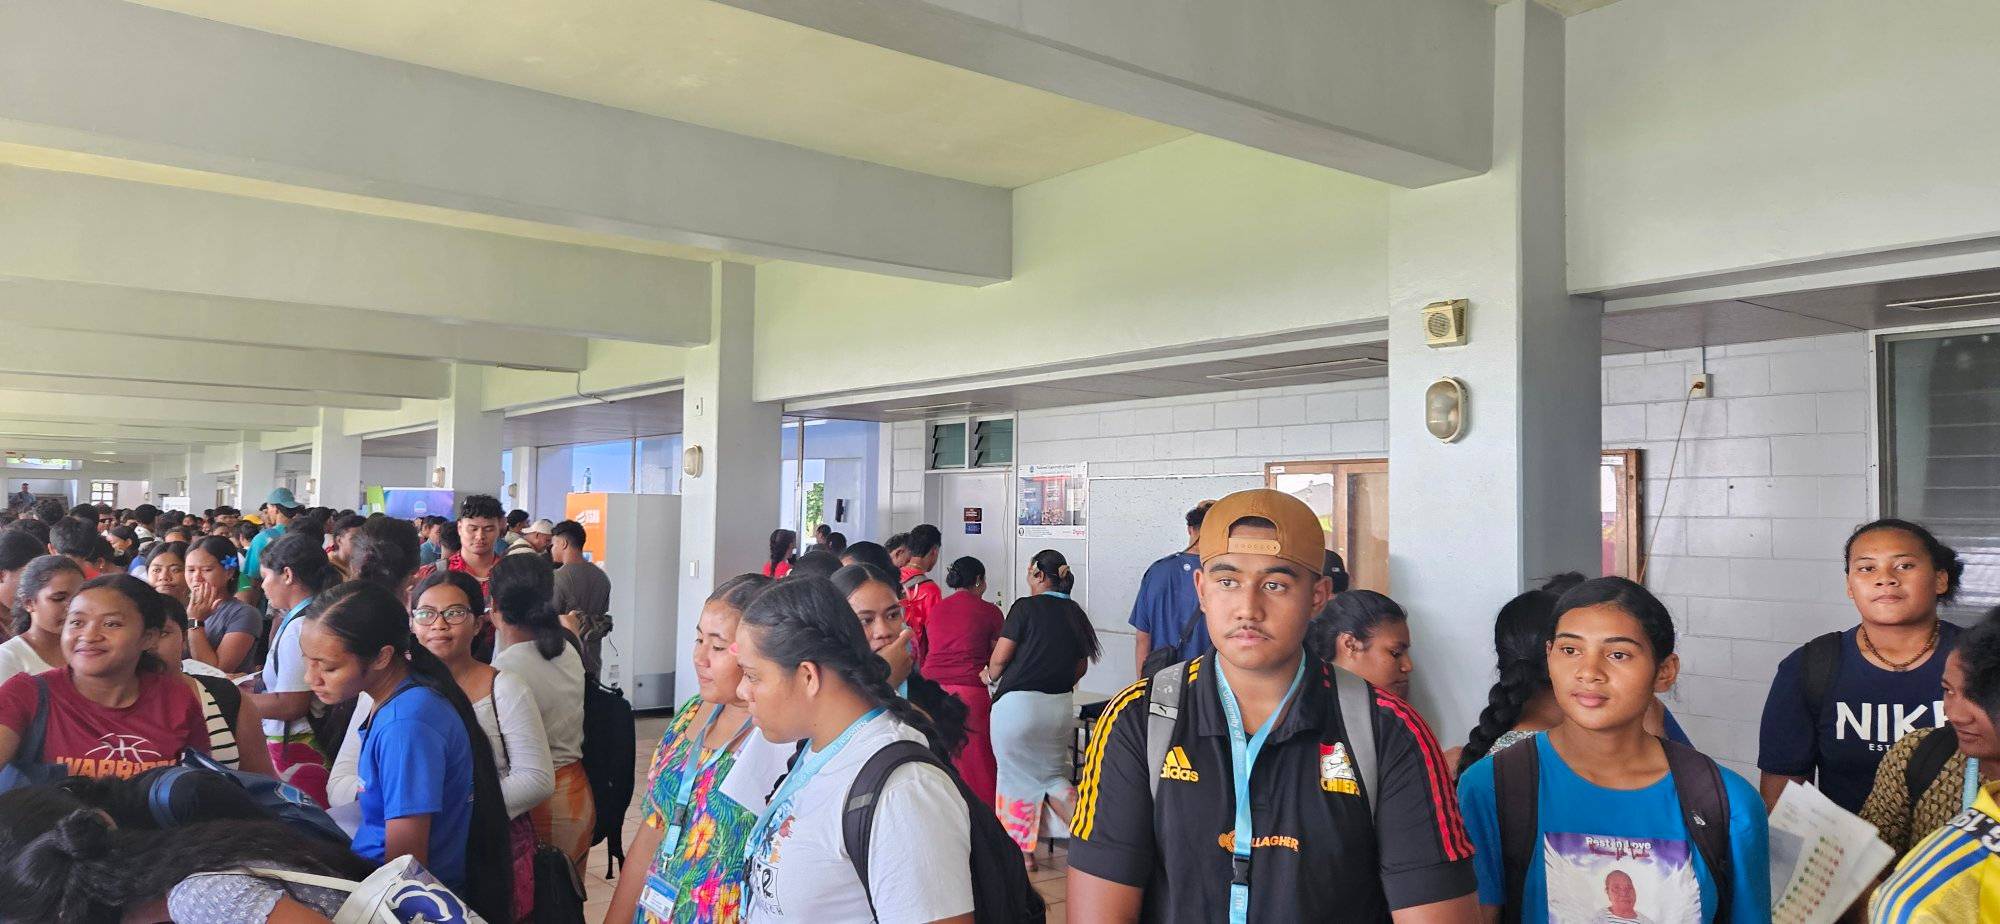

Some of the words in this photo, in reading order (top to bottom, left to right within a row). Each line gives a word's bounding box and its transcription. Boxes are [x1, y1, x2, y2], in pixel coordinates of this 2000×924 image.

[56, 756, 177, 780] WARRI
[1160, 763, 1199, 783] didas
[1252, 836, 1299, 851] LLAGHER
